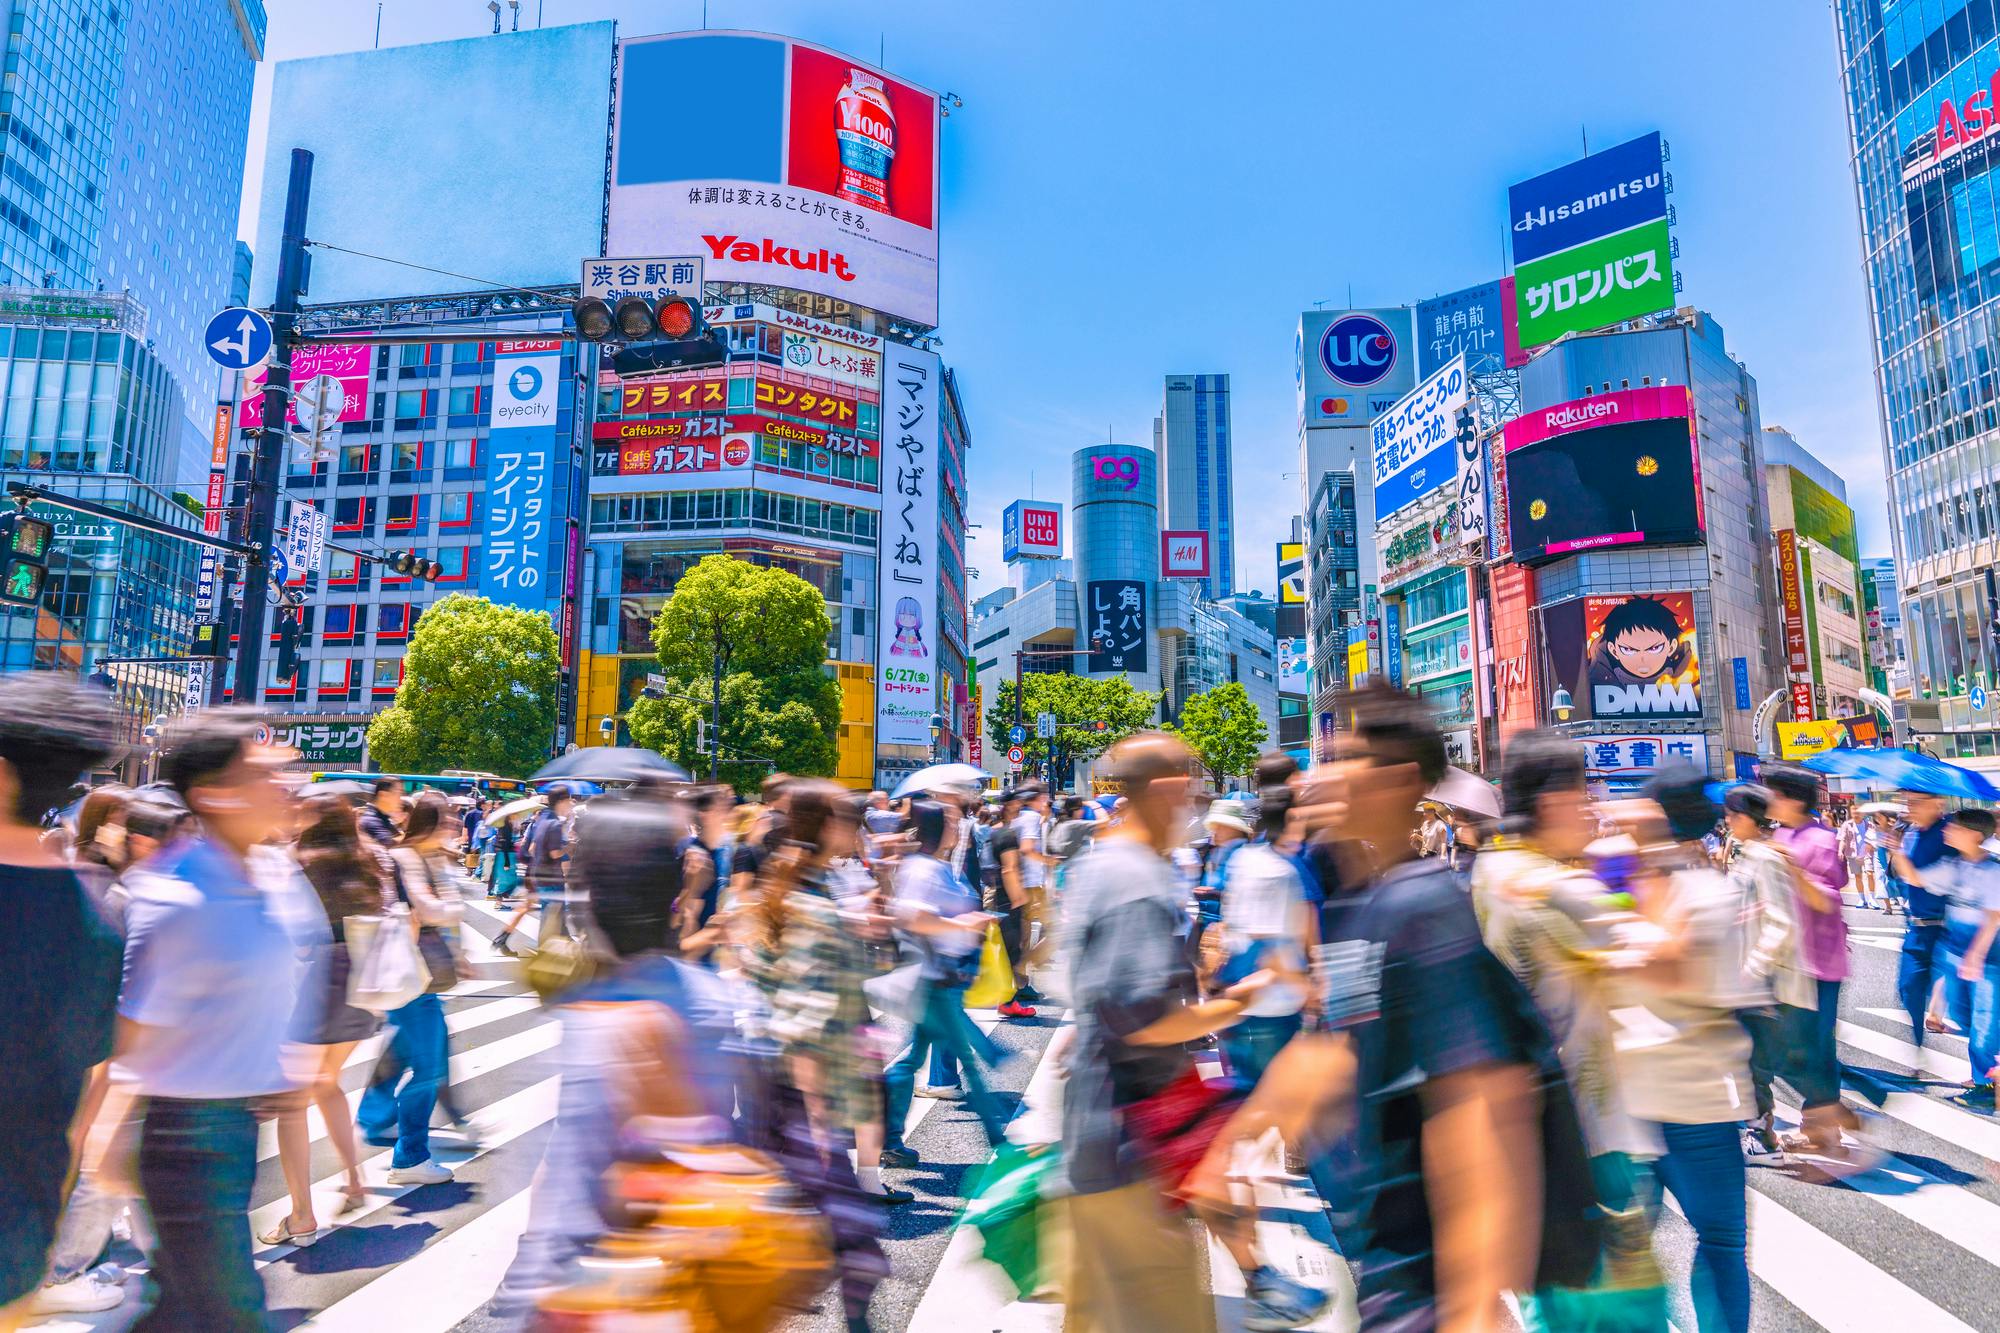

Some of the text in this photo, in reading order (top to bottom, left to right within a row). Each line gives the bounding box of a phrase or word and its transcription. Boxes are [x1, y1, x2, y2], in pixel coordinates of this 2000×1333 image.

[853, 90, 882, 106] Yakult
[839, 101, 893, 146] Y1000
[1513, 172, 1660, 231] Hisamitsu
[701, 235, 857, 282] Yakult
[592, 262, 695, 287] 渋谷駅前
[1525, 249, 1662, 319] サロンパス
[776, 310, 879, 348] しゃぶしゃぶバイキング
[1435, 304, 1485, 337] 龍角散
[1328, 333, 1389, 367] UC
[1430, 329, 1495, 360] ダイレクト
[300, 357, 357, 374] クリニック
[817, 346, 876, 378] しゃぶ葉
[499, 403, 550, 419] eyecity
[625, 382, 853, 420] プライス コンタクト
[1373, 368, 1462, 453] 観るってこころの
[1546, 401, 1619, 428] Rakuten
[684, 417, 734, 438] ガスト
[595, 452, 619, 468] 7F
[624, 449, 651, 463] Café
[653, 444, 716, 472] ガスト
[727, 451, 747, 460] ガスト
[826, 432, 870, 457] ガスト
[1375, 414, 1447, 482] 充電というか。
[893, 362, 926, 585] 『マジやばくね』
[1090, 456, 1140, 491] 109
[1410, 467, 1427, 486] prime
[1457, 407, 1484, 535] もんじゃ
[54, 523, 116, 536] CITY
[489, 453, 522, 588] アイシティ
[518, 451, 545, 588] コンタクトの
[1027, 513, 1052, 528] UNI
[295, 508, 311, 568] 渋谷駅前
[1027, 528, 1055, 543] QLO
[1570, 536, 1613, 549] Rakuten Vision
[199, 545, 215, 597] 加藤眼科
[1781, 533, 1798, 610] クスリのことなら
[1118, 585, 1142, 652] 角パン
[885, 667, 930, 683] 6/27(金)
[885, 683, 930, 694] ロードショー
[1594, 683, 1700, 713] DMM
[1584, 741, 1693, 768] 堂書店
